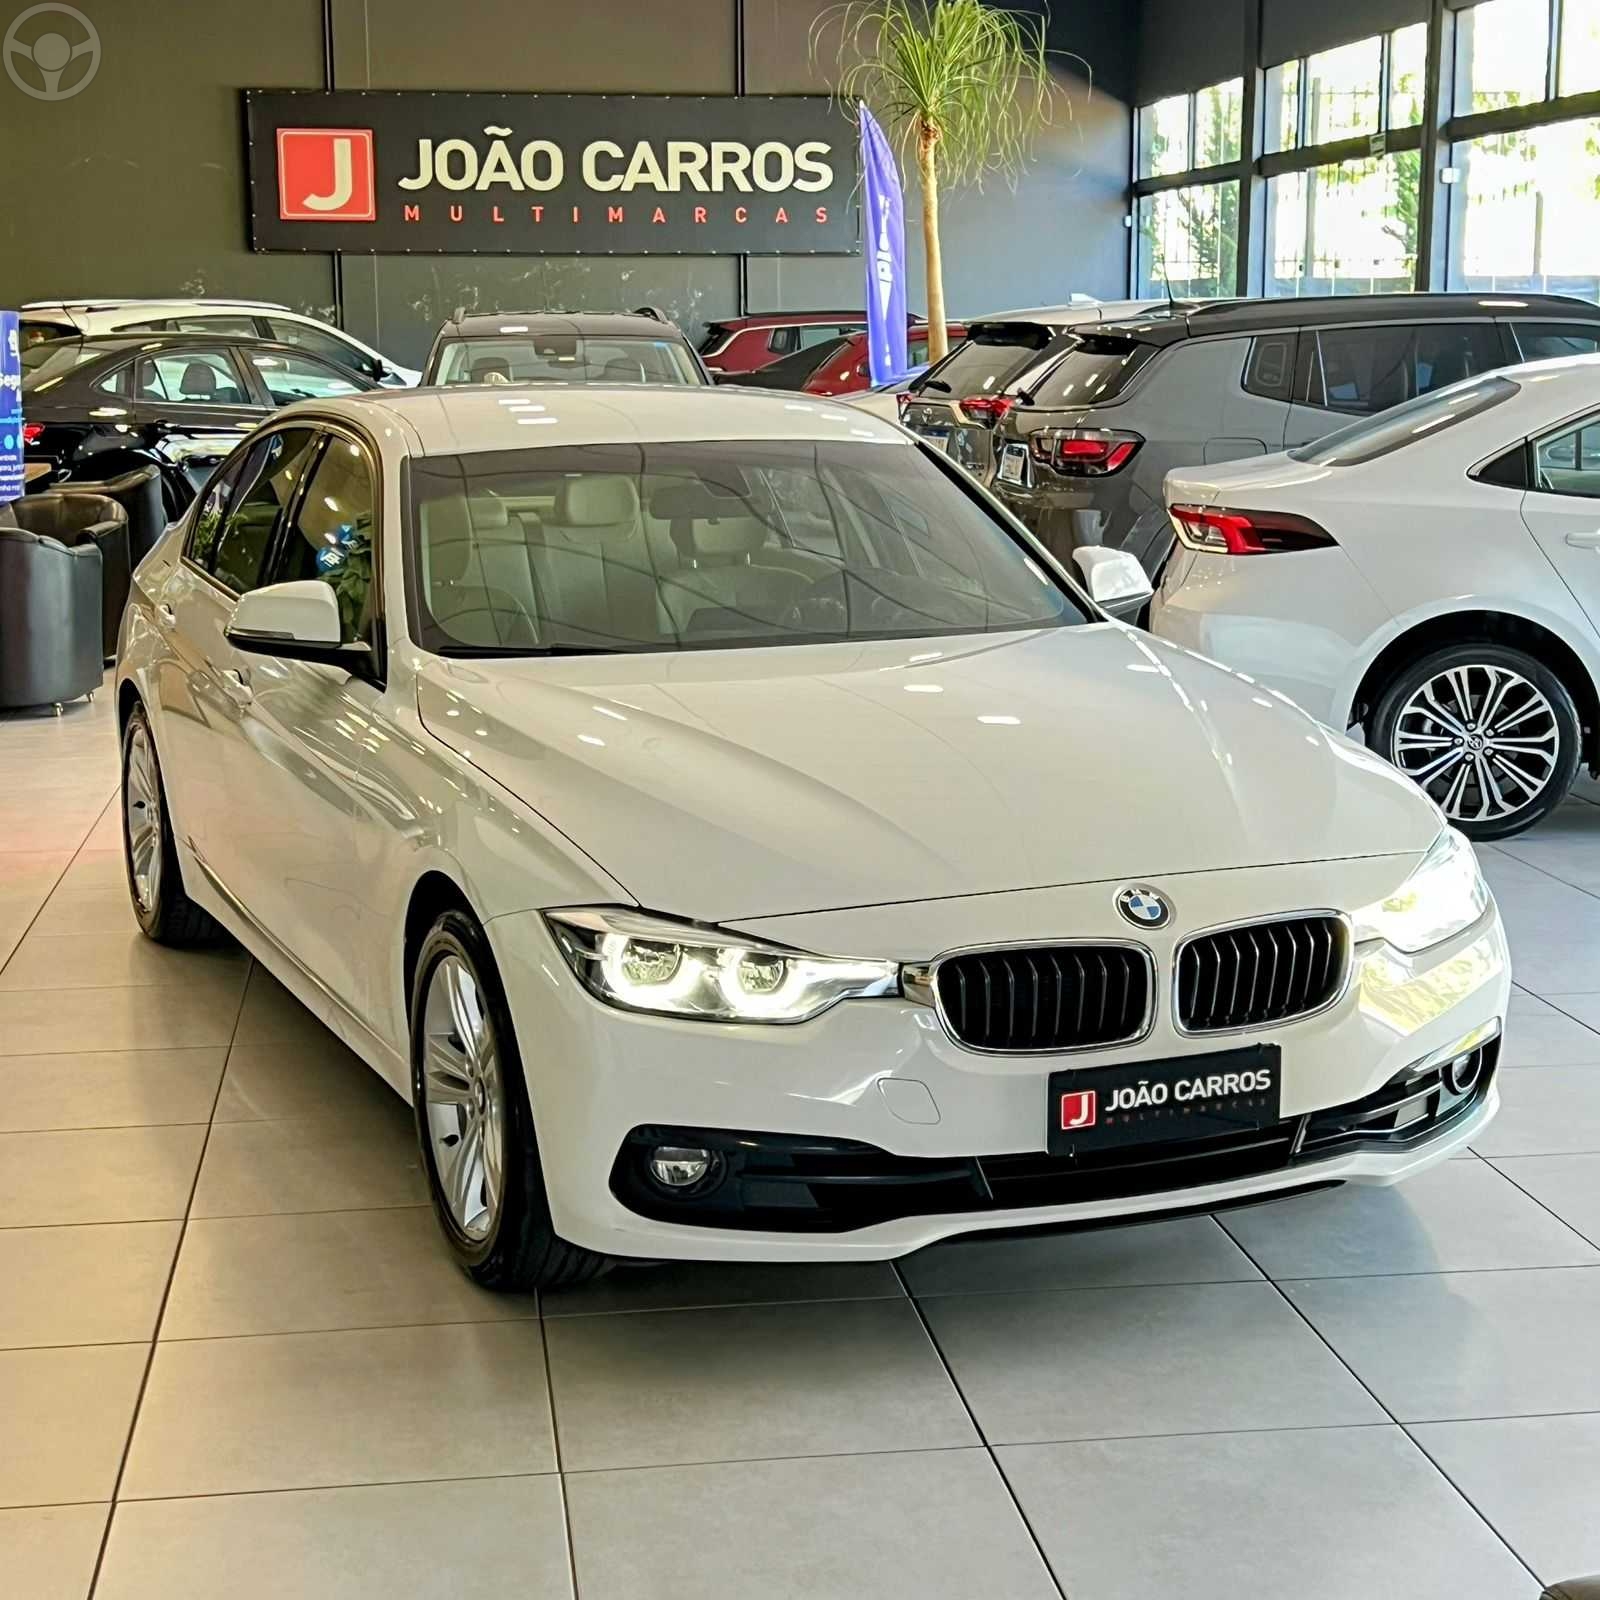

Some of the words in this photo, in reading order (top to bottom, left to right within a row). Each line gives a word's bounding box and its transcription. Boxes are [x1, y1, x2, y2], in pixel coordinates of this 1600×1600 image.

[303, 138, 352, 211] J
[399, 125, 564, 191] JOÃO
[583, 140, 834, 192] CARROS
[403, 204, 829, 224] MULTIMARCAS
[1069, 1094, 1089, 1126] J
[1104, 1080, 1168, 1112] JOÃO
[1174, 1068, 1272, 1102] CARROS
